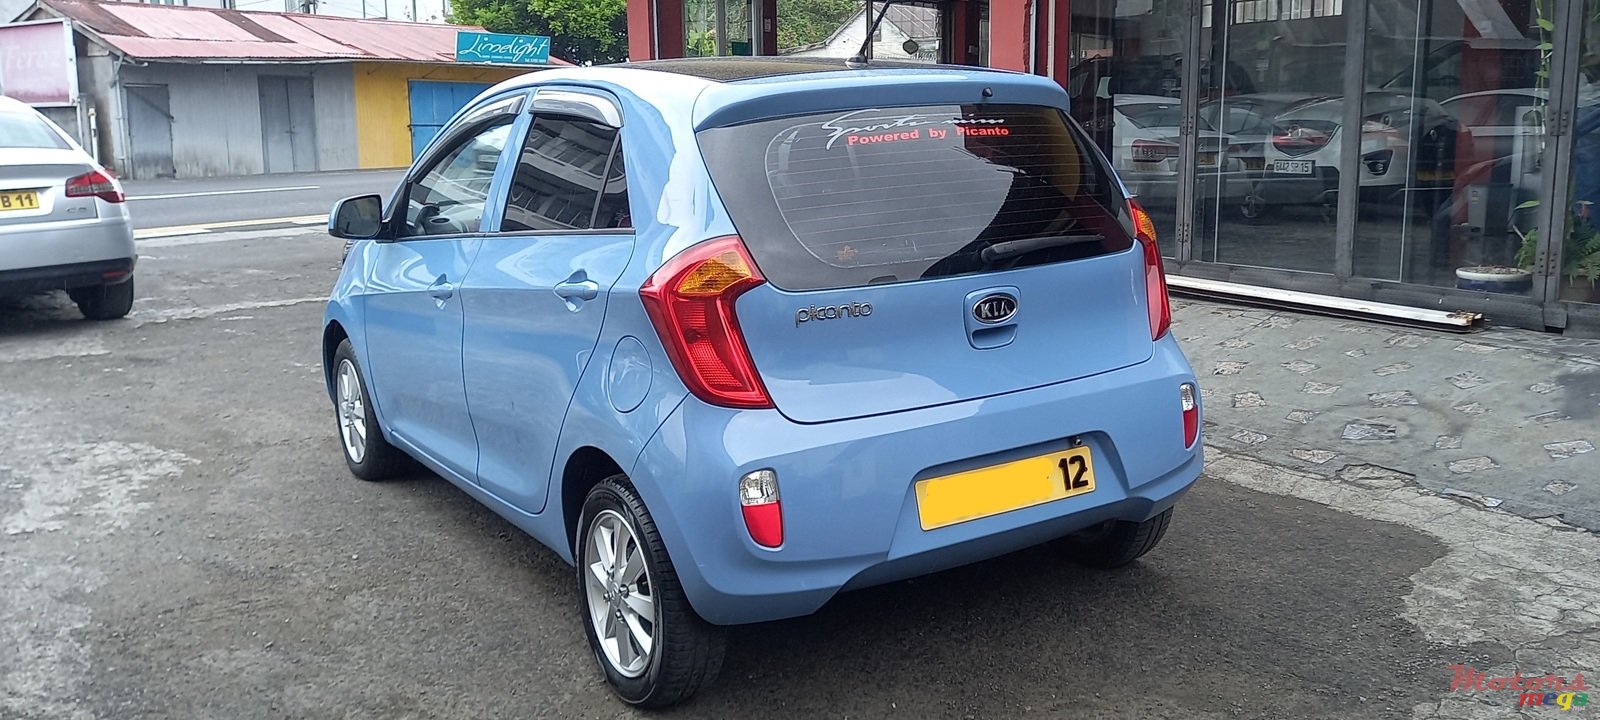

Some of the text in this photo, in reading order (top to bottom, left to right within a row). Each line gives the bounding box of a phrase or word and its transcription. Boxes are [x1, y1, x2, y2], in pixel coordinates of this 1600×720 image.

[459, 34, 549, 62] Limelight
[847, 125, 1010, 147] Powered by Picanto
[1301, 162, 1309, 172] 15
[1, 193, 34, 208] B 11
[794, 301, 874, 328] picanto
[980, 299, 1012, 319] KIA
[1057, 454, 1089, 491] 12
